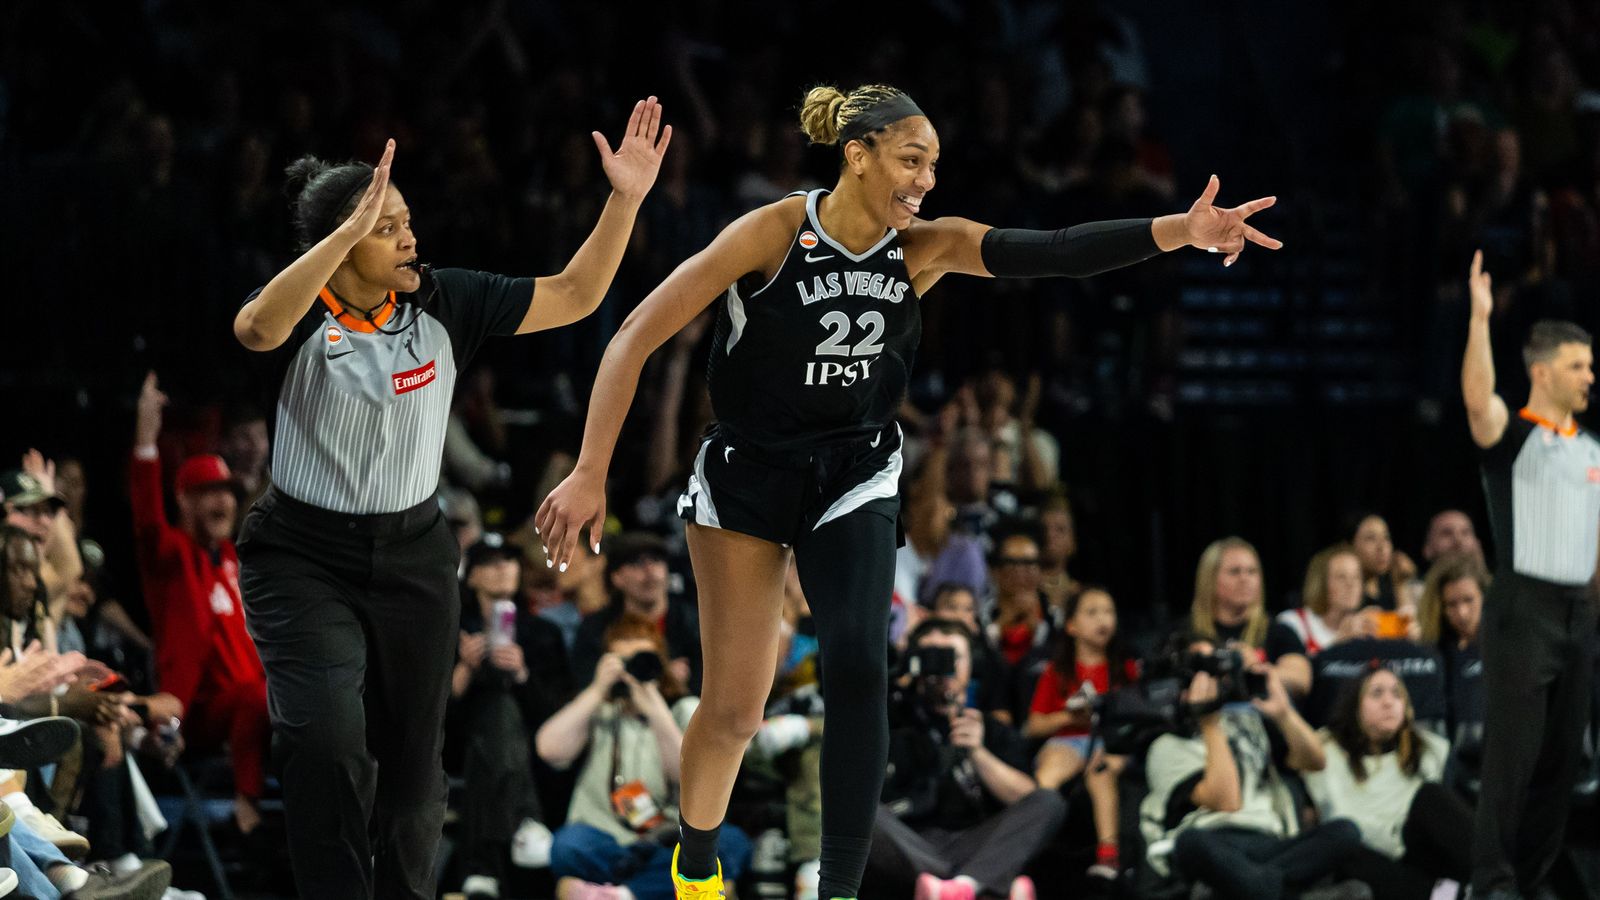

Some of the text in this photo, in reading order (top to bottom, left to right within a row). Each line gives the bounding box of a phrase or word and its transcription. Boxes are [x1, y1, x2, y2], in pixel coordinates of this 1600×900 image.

[796, 271, 909, 306] LAS VEGAS
[815, 310, 885, 357] 22
[804, 355, 880, 387] IPSY
